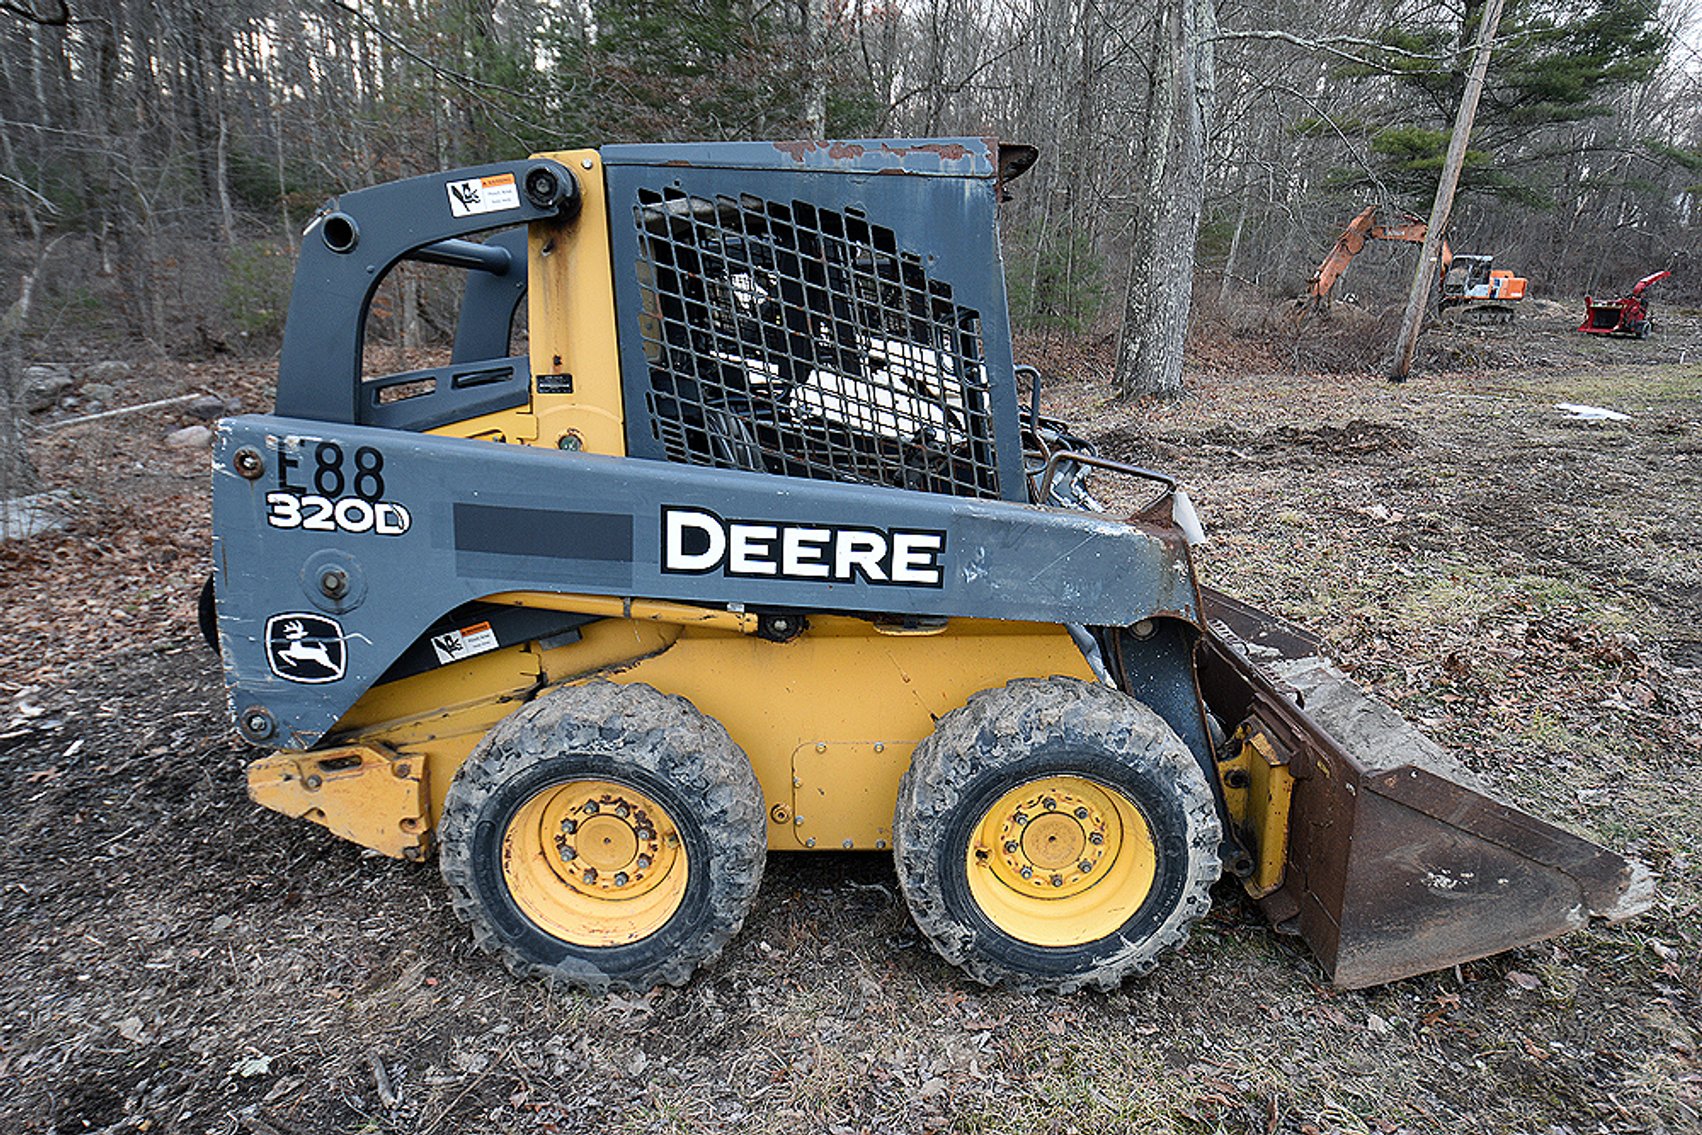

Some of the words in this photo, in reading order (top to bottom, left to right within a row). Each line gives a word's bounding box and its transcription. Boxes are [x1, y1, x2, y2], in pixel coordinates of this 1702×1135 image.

[277, 435, 385, 502] E88
[266, 491, 412, 535] 320D
[664, 508, 944, 585] DEERE
